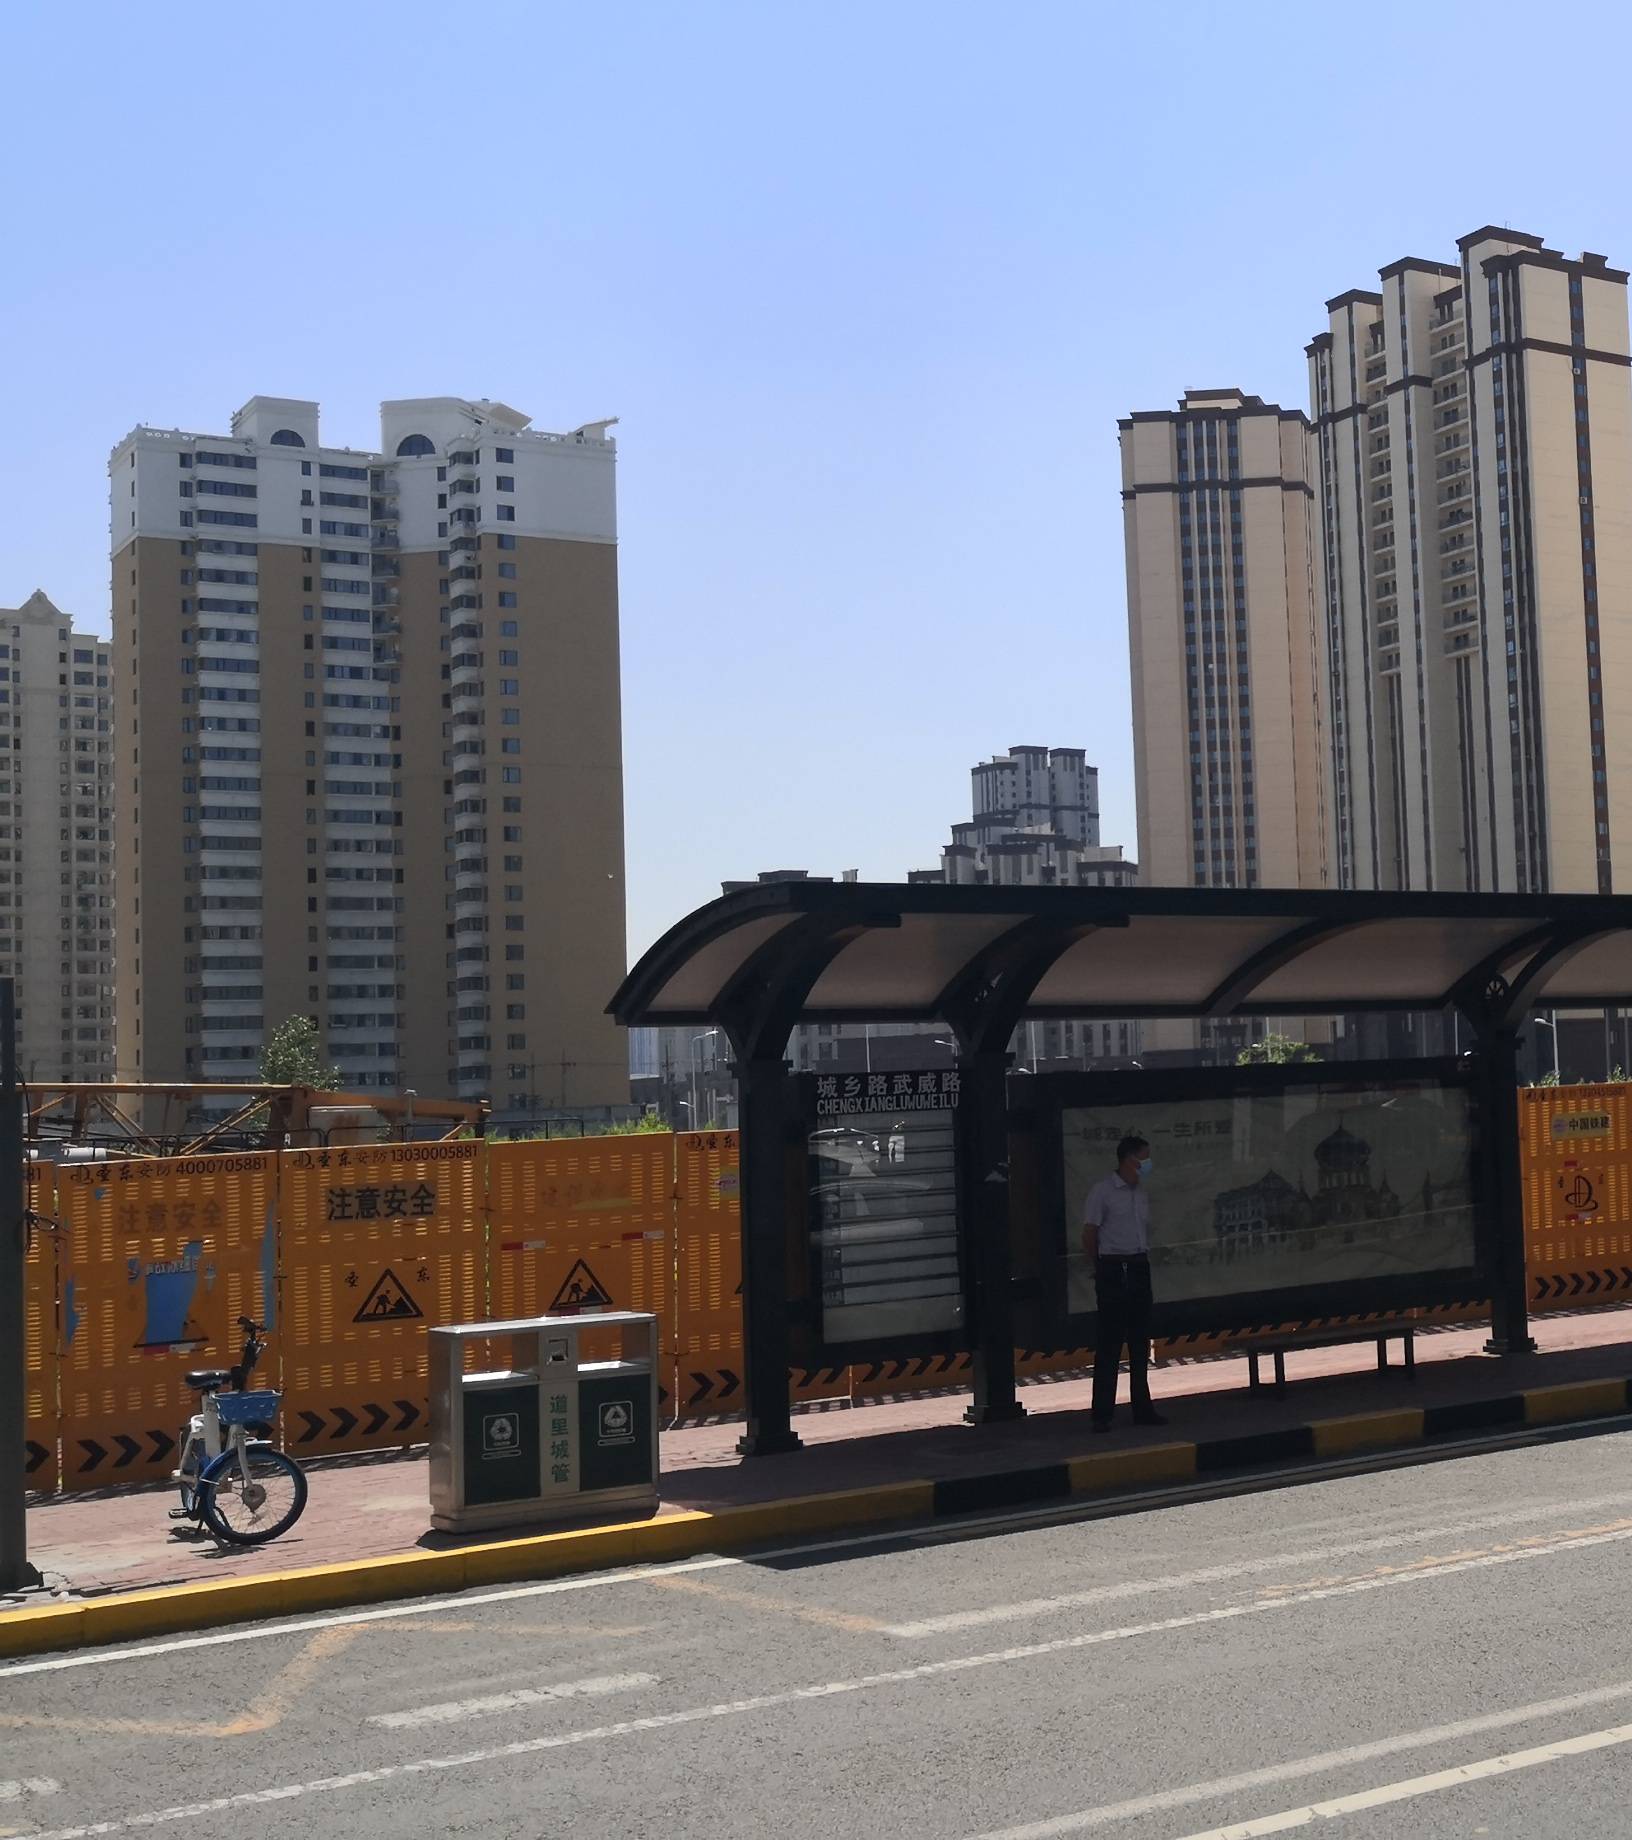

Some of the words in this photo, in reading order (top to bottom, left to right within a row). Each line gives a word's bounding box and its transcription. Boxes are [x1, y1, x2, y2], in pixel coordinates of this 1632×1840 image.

[816, 1073, 961, 1098] 城乡路武威路
[816, 1093, 959, 1115] CHENGXIANGLUWUWEILU
[1568, 1116, 1610, 1131] 中国铁建
[391, 1145, 479, 1162] 13030005881
[175, 1156, 268, 1175] 4000705881
[328, 1184, 436, 1221] 注意安全
[118, 1201, 223, 1235] 注意安全
[550, 1394, 570, 1484] 道里城管
